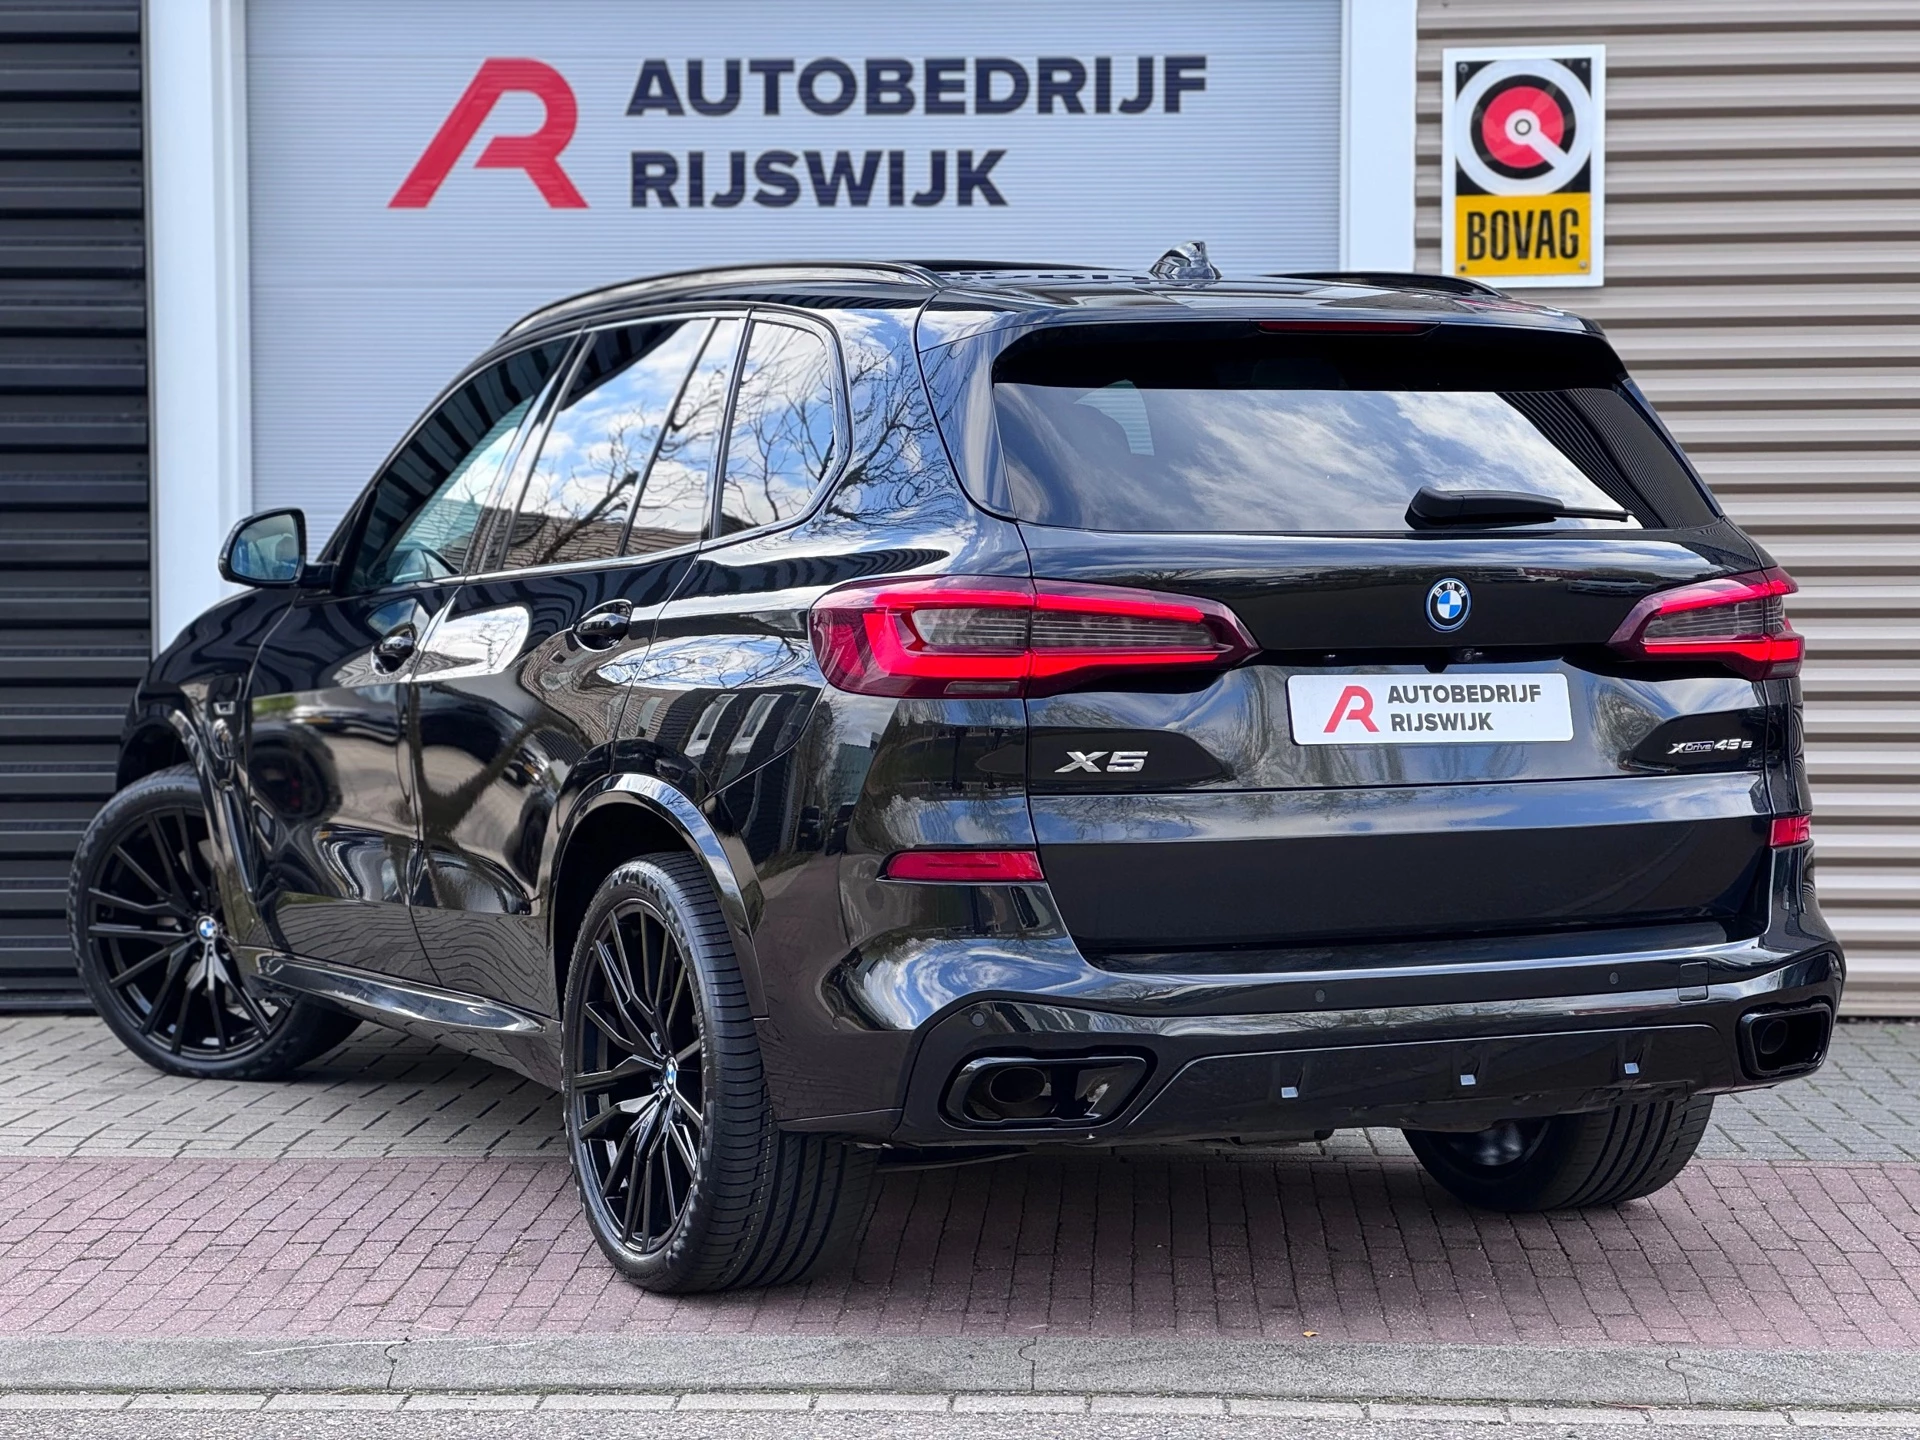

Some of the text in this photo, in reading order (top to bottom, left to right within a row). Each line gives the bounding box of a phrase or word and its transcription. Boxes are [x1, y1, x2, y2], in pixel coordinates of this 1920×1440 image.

[625, 56, 1207, 117] AUTOBEDRIJF
[630, 149, 1009, 209] RIJSWIJK
[1467, 208, 1579, 261] BOVAG
[1434, 582, 1467, 598] BMW
[1388, 684, 1541, 704] AUTOBEDRIJF
[1390, 712, 1494, 732] RIJSWIJK
[1054, 751, 1148, 773] X5
